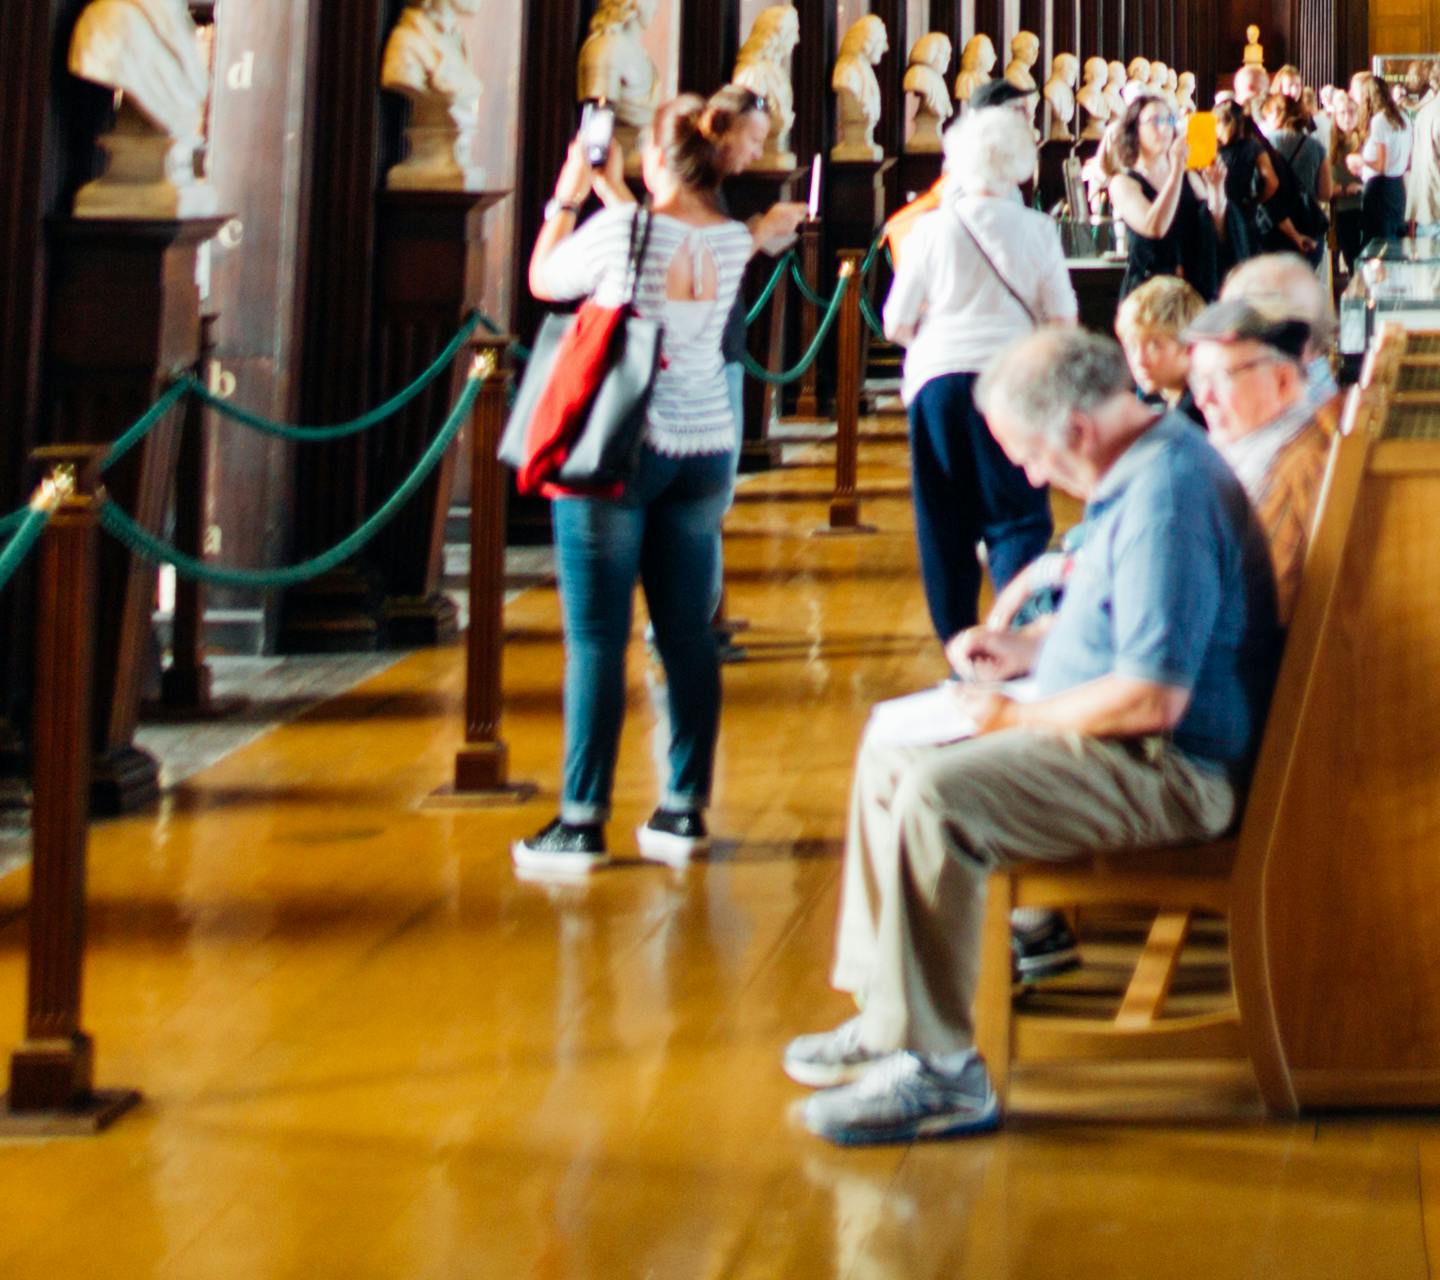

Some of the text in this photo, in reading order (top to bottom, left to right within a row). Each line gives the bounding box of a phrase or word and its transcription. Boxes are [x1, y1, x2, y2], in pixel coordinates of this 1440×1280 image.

[227, 51, 253, 90] d
[219, 219, 242, 248] c
[208, 361, 235, 399] b
